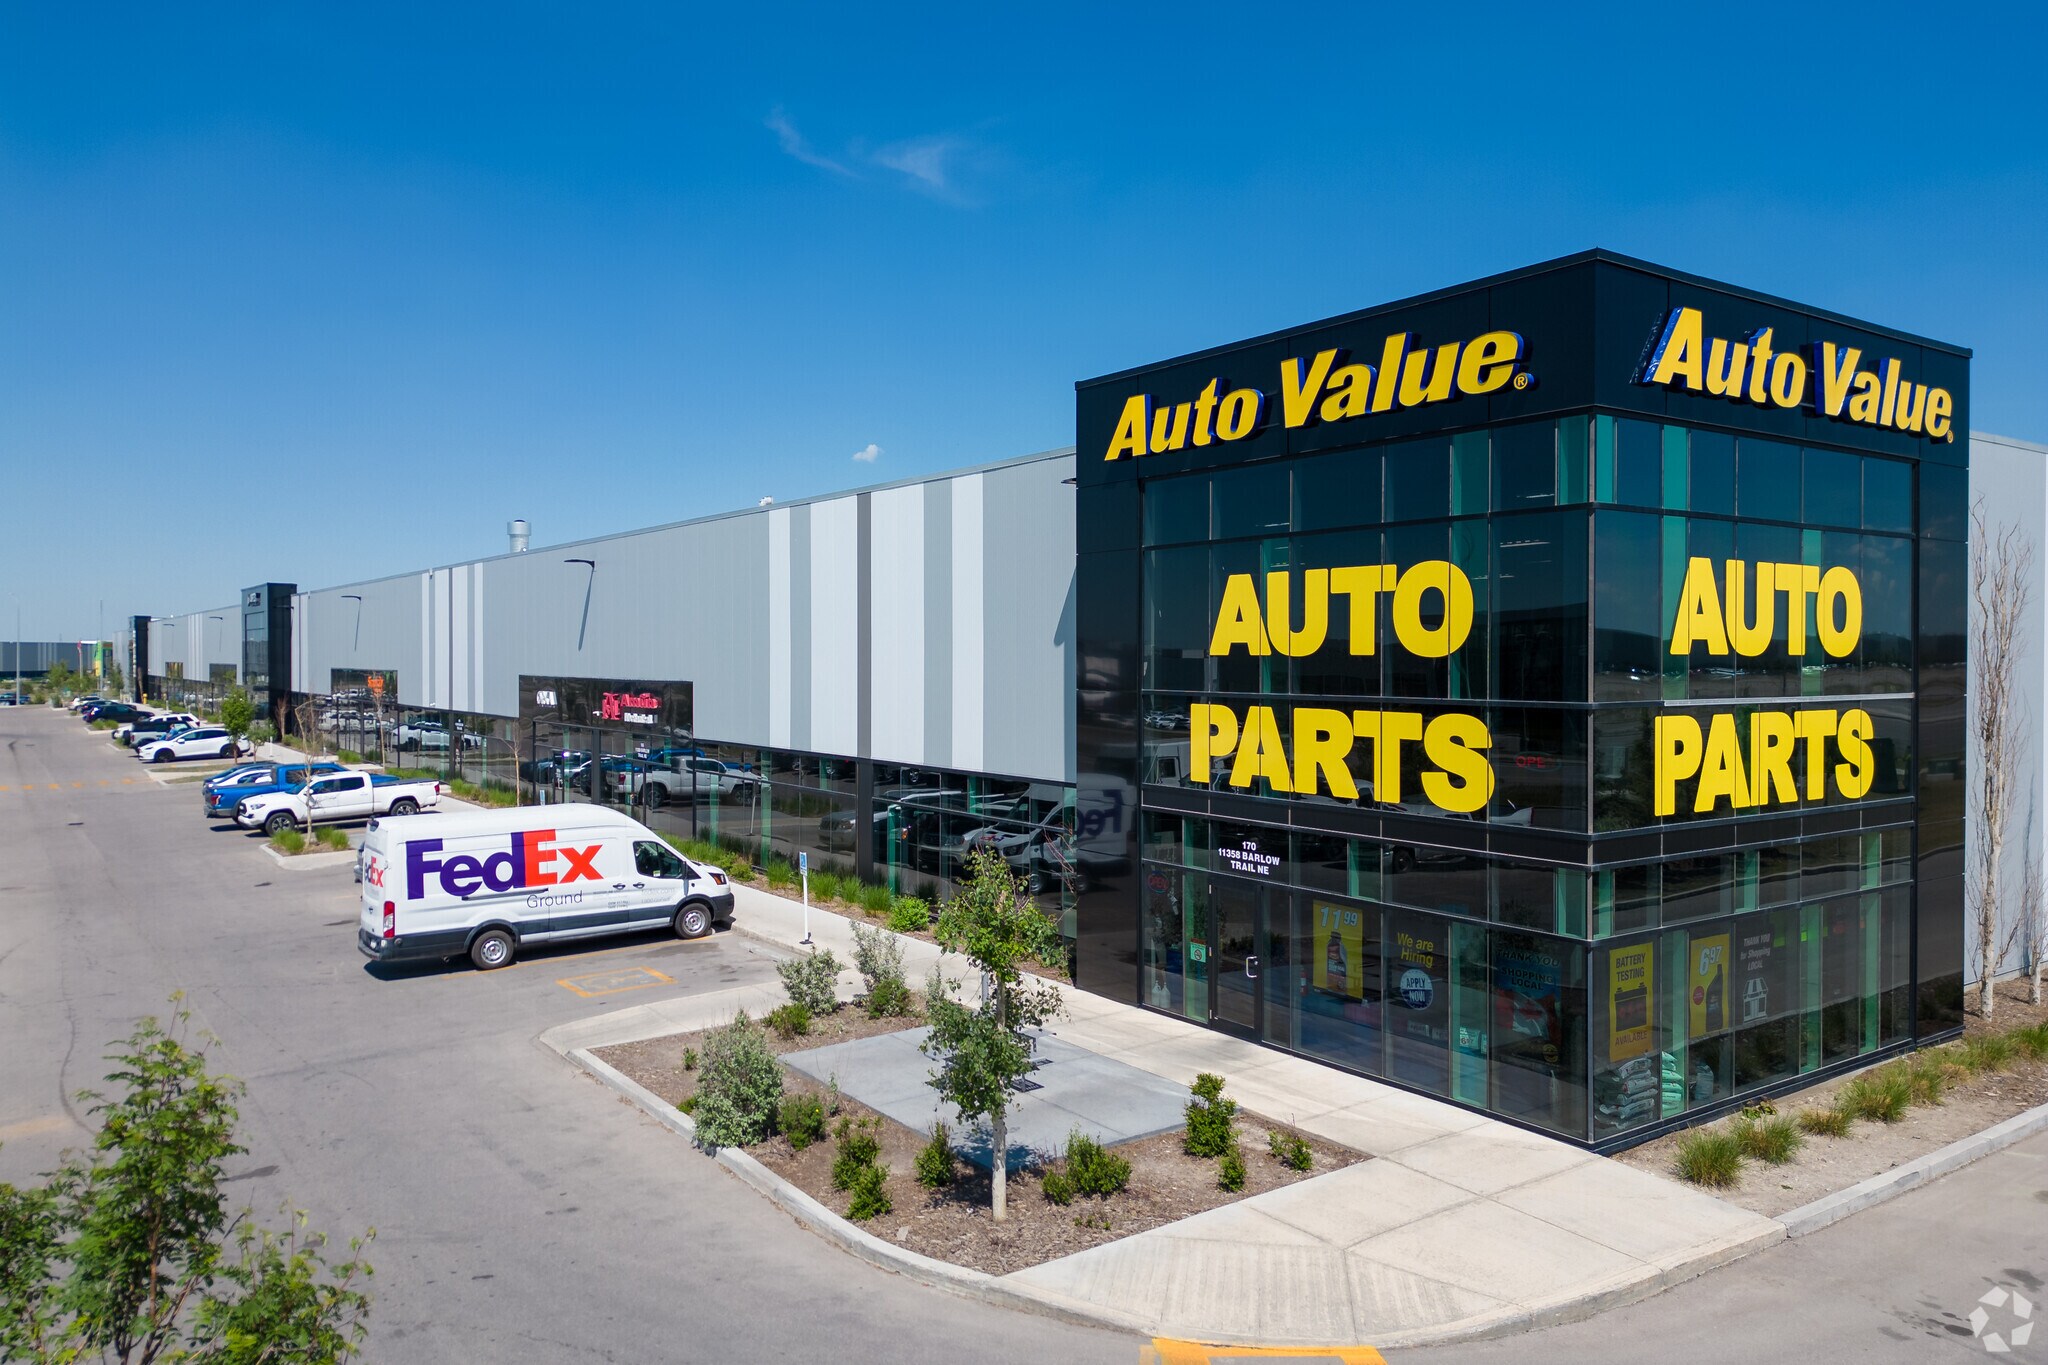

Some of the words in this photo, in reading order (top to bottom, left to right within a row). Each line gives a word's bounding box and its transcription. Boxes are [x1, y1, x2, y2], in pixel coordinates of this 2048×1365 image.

[1646, 306, 1806, 408] Auto
[1104, 377, 1264, 461] Auto
[1209, 560, 1474, 657] AUTO
[1670, 556, 1862, 657] AUTO
[1190, 703, 1495, 812] PARTS
[1654, 708, 1874, 816] PARTS
[1242, 841, 1256, 851] 170
[406, 829, 604, 900] FedEx
[1218, 848, 1240, 859] 11358
[1242, 851, 1280, 865] BARLOW
[1230, 860, 1256, 873] TRAIL
[1257, 865, 1269, 875] NE
[526, 890, 583, 909] Ground
[1397, 932, 1413, 947] We
[1415, 938, 1434, 951] are
[1401, 948, 1434, 968] Hiring
[1616, 953, 1646, 968] BATTERY
[1406, 978, 1426, 989] APPLY
[1501, 968, 1553, 983] SHOPPING
[1616, 967, 1645, 982] TESTING
[1511, 977, 1544, 991] LOCAL
[1409, 990, 1426, 1003] NOW
[1615, 1031, 1647, 1046] AVAILABLE
